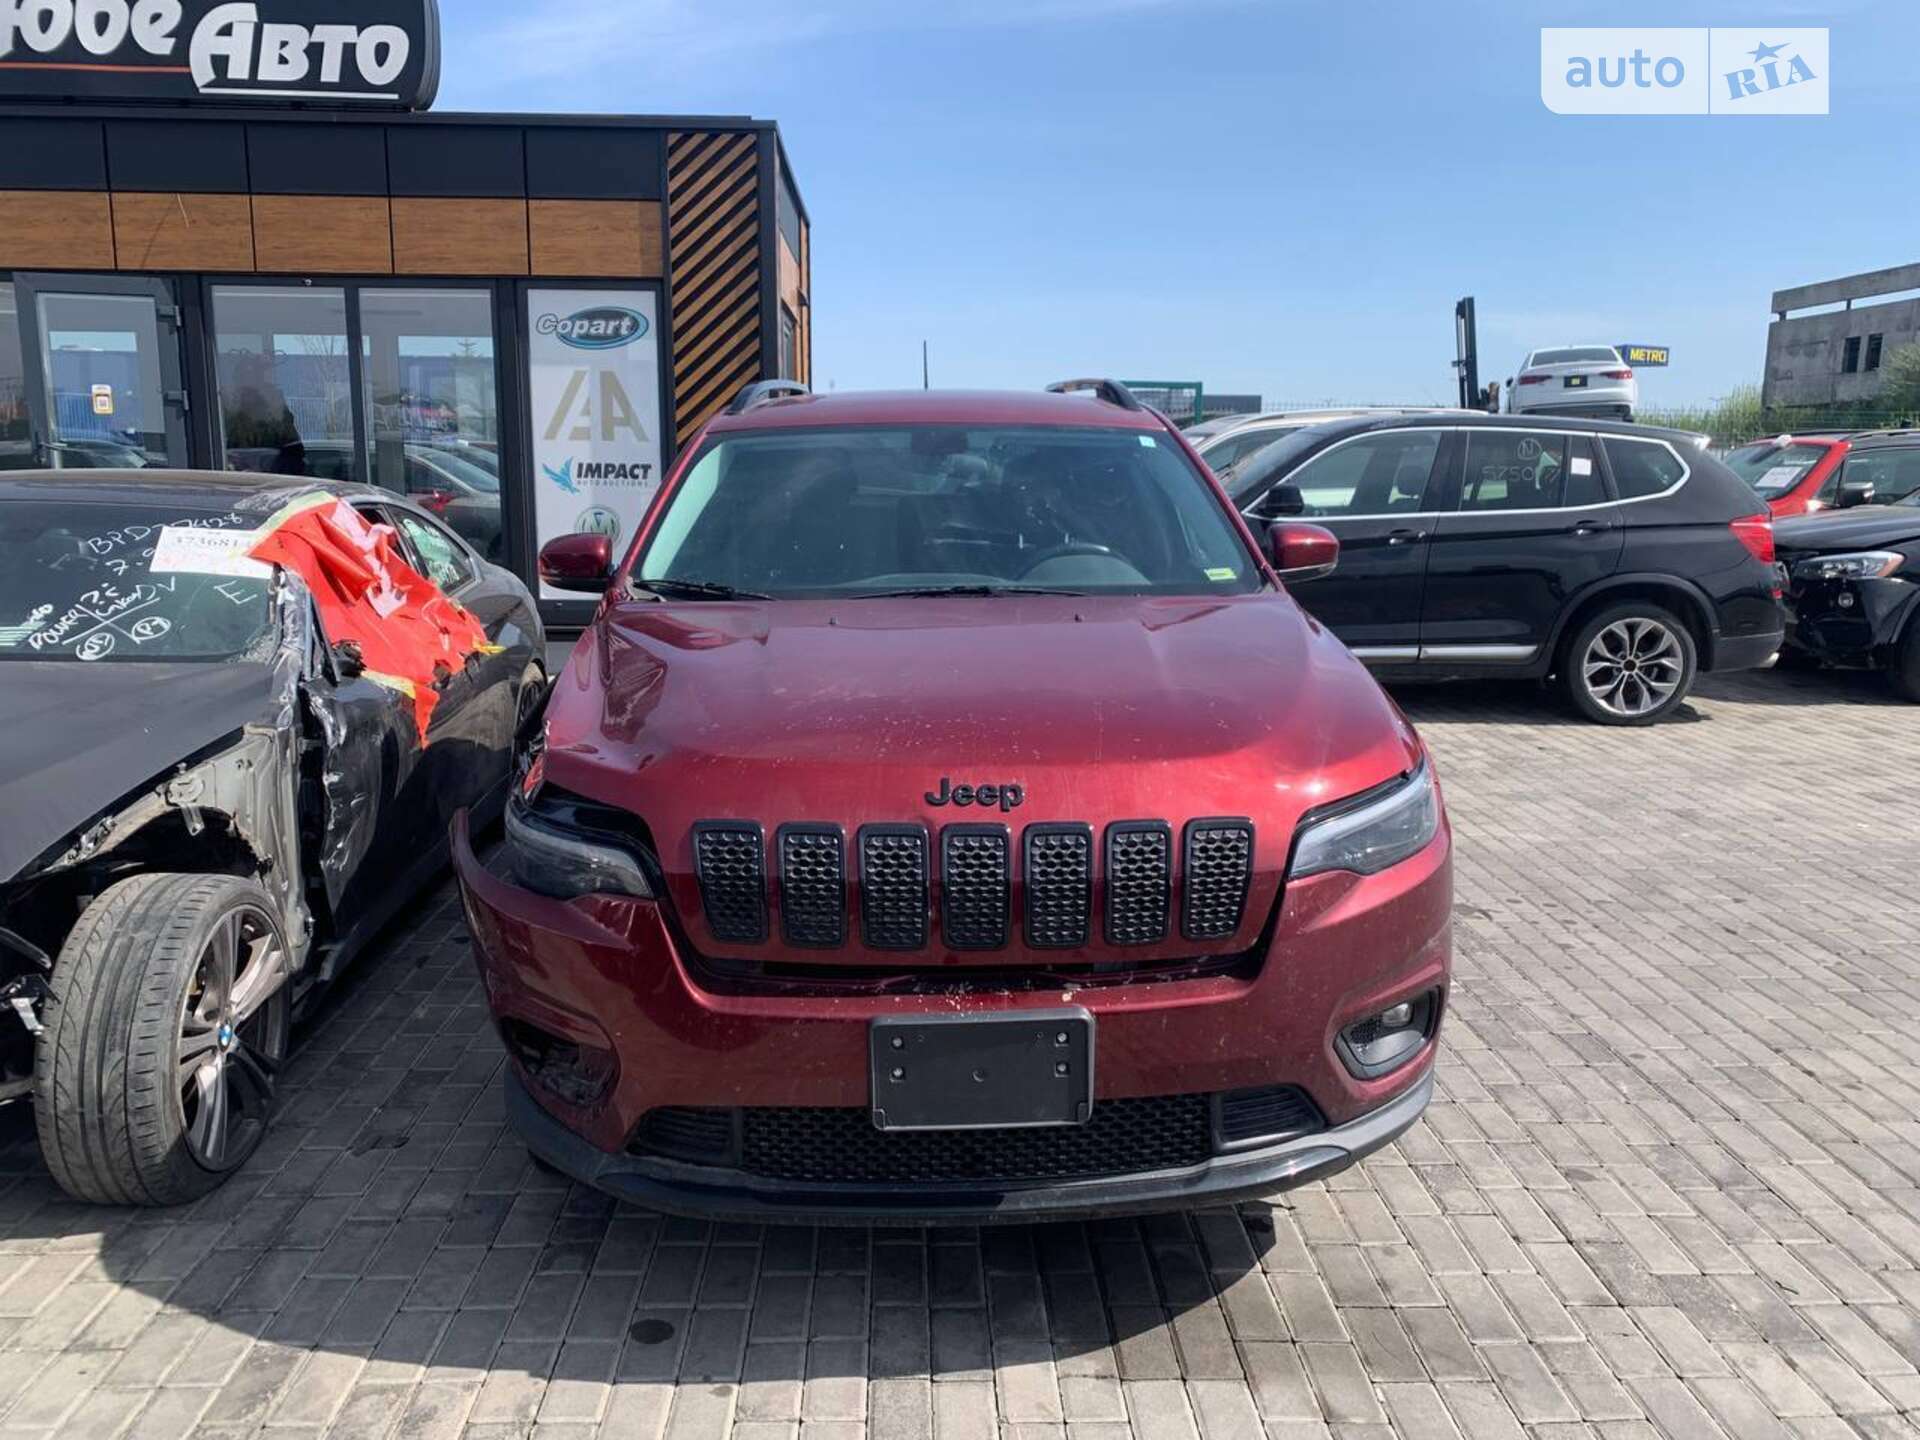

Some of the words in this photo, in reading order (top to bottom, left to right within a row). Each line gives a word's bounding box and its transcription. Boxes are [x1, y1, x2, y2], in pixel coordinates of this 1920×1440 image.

[536, 313, 631, 338] Copart
[1630, 347, 1666, 362] METRO
[577, 462, 652, 480] IMPACT
[924, 777, 1024, 812] Jeep
